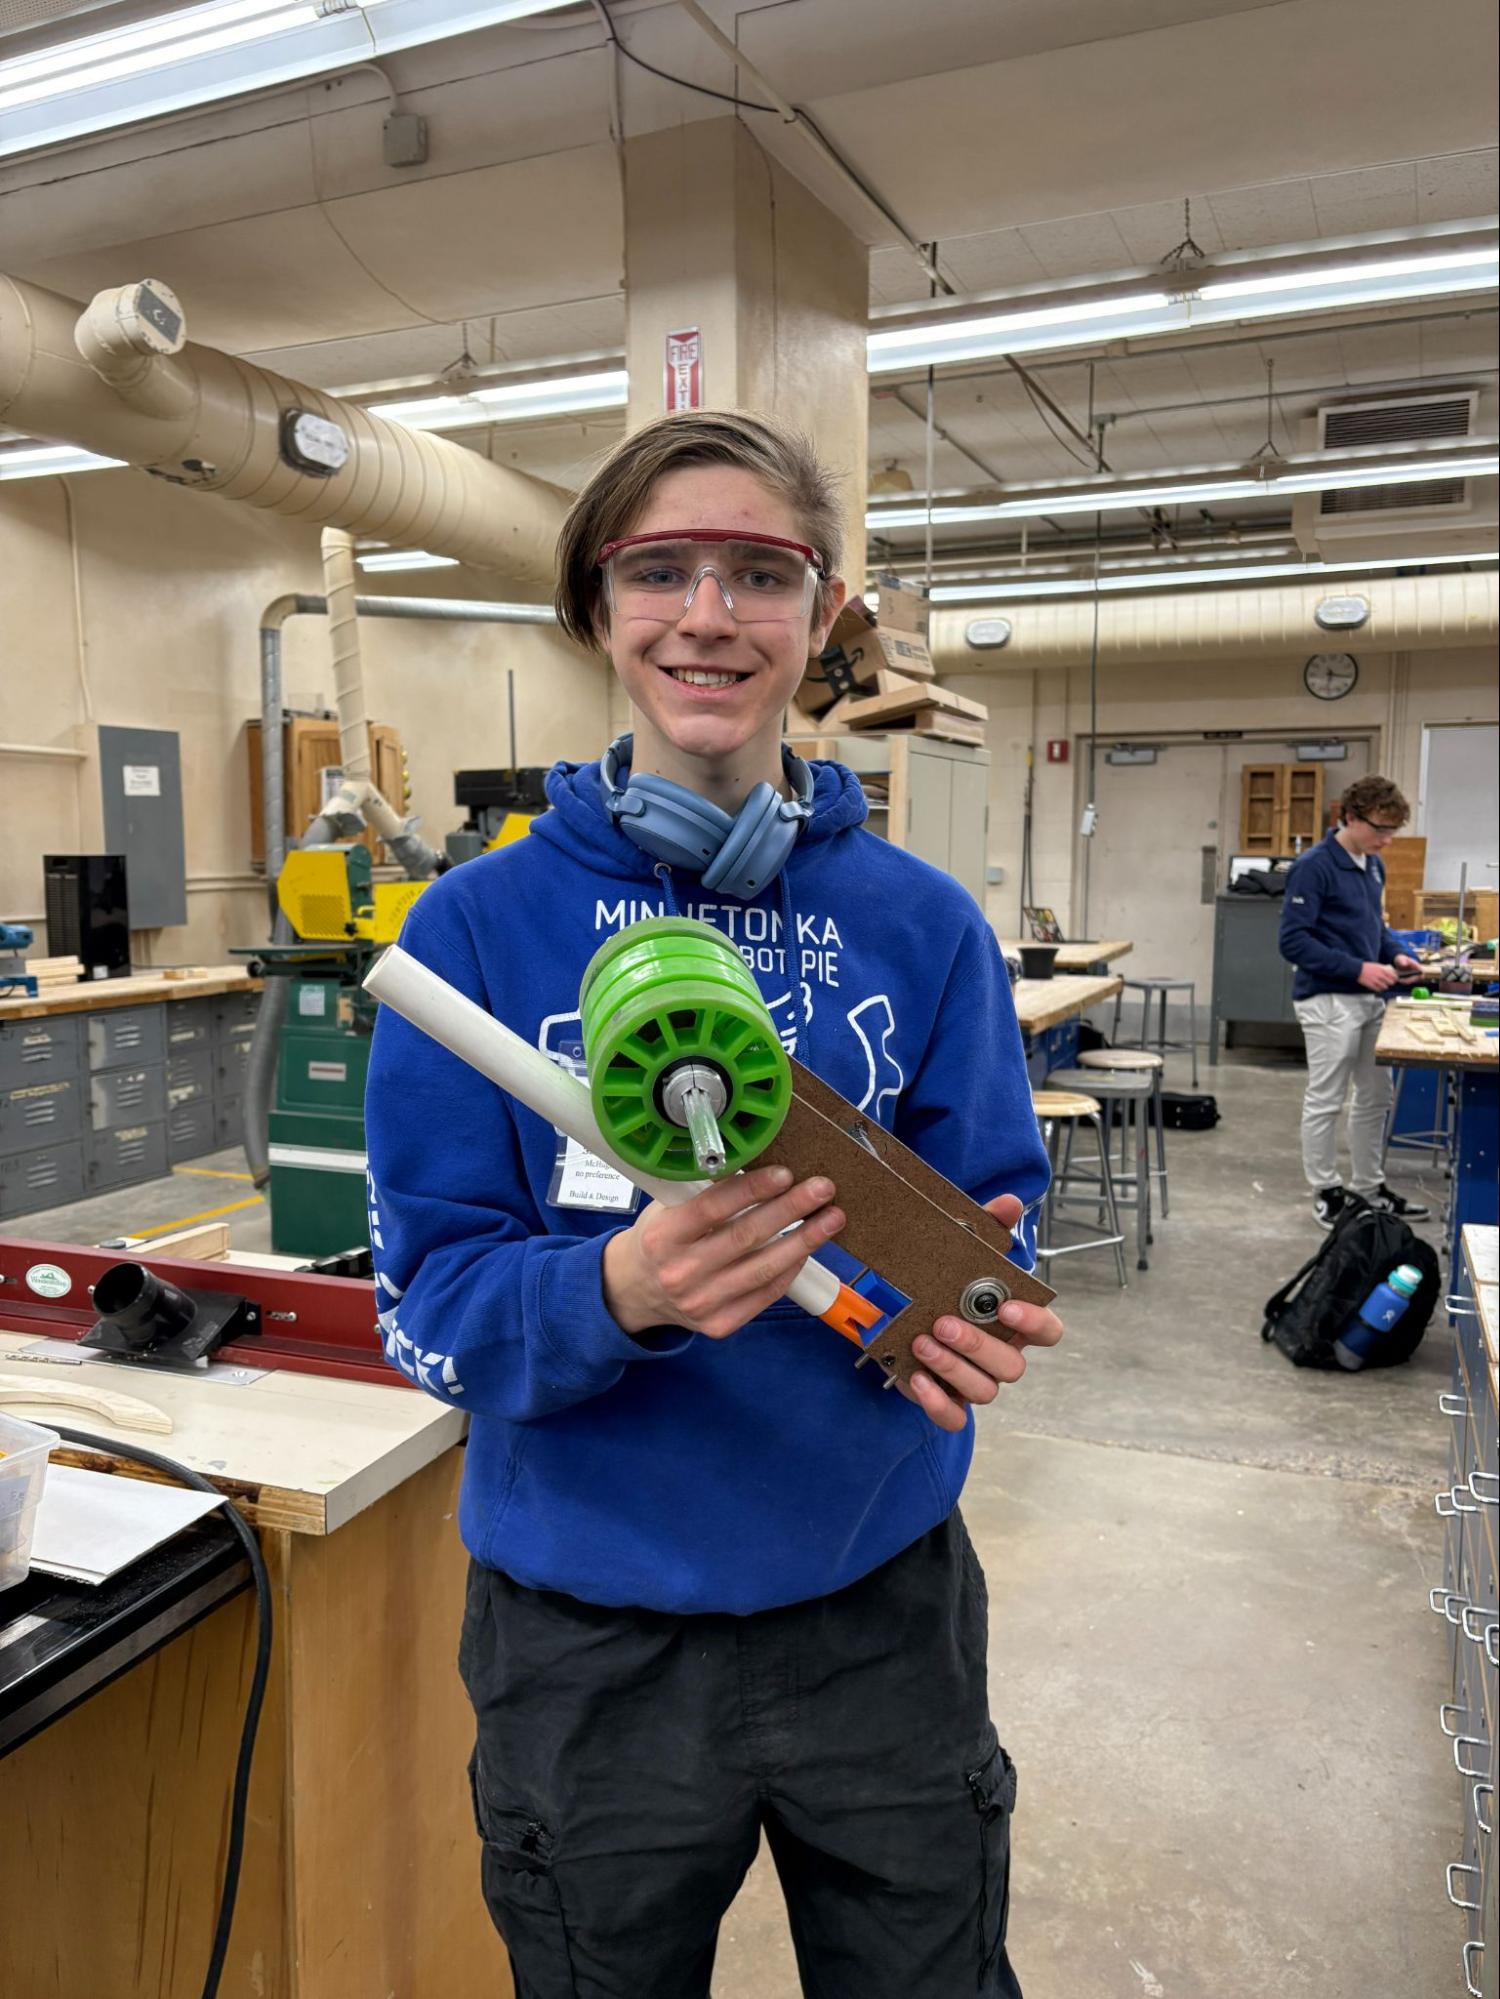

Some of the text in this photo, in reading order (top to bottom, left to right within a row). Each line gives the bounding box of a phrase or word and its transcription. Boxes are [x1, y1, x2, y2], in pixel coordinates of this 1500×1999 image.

[671, 343, 697, 362] FIRE
[594, 899, 843, 949] MINETONKA
[801, 949, 840, 988] PIE
[585, 1170, 620, 1181] preference
[569, 1190, 587, 1199] Build
[596, 1192, 619, 1203] Design
